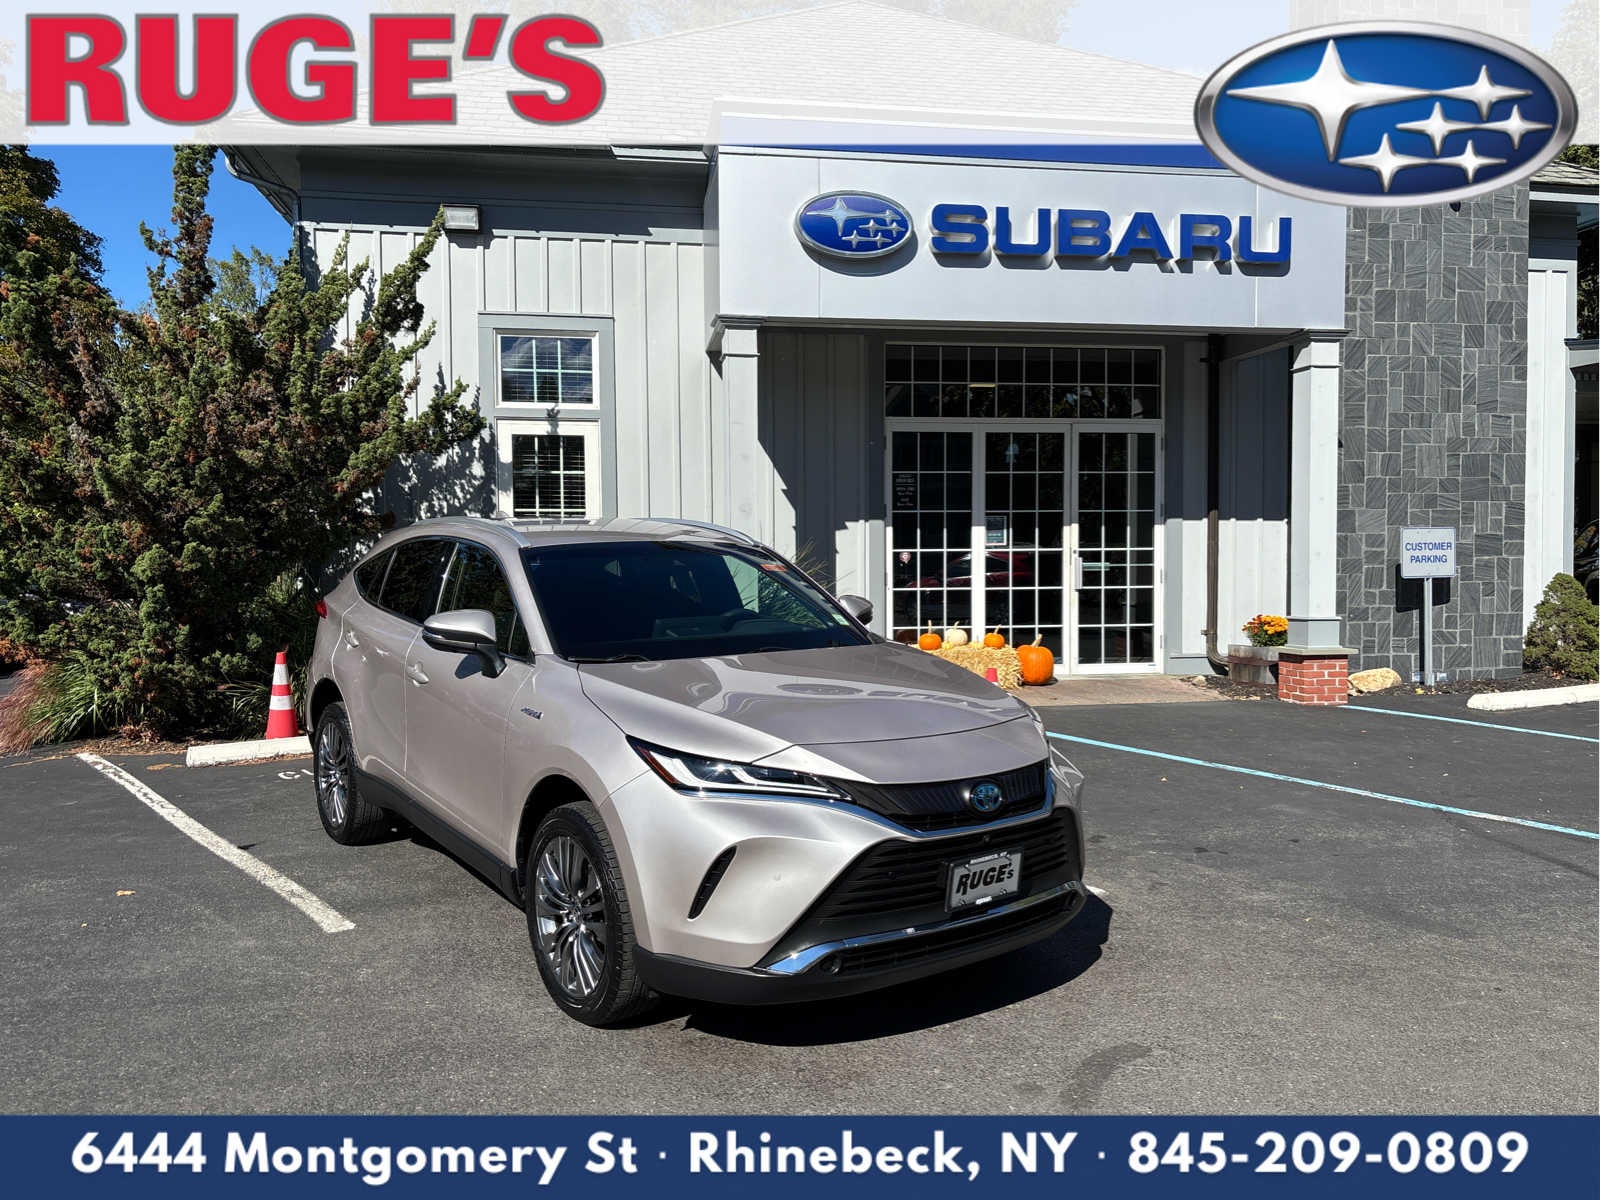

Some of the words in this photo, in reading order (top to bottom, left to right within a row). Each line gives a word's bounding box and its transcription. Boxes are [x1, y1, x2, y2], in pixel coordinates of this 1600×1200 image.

[930, 203, 1293, 265] SUBARU
[1405, 542, 1452, 551] CUSTOMER
[1409, 554, 1448, 564] PARKING
